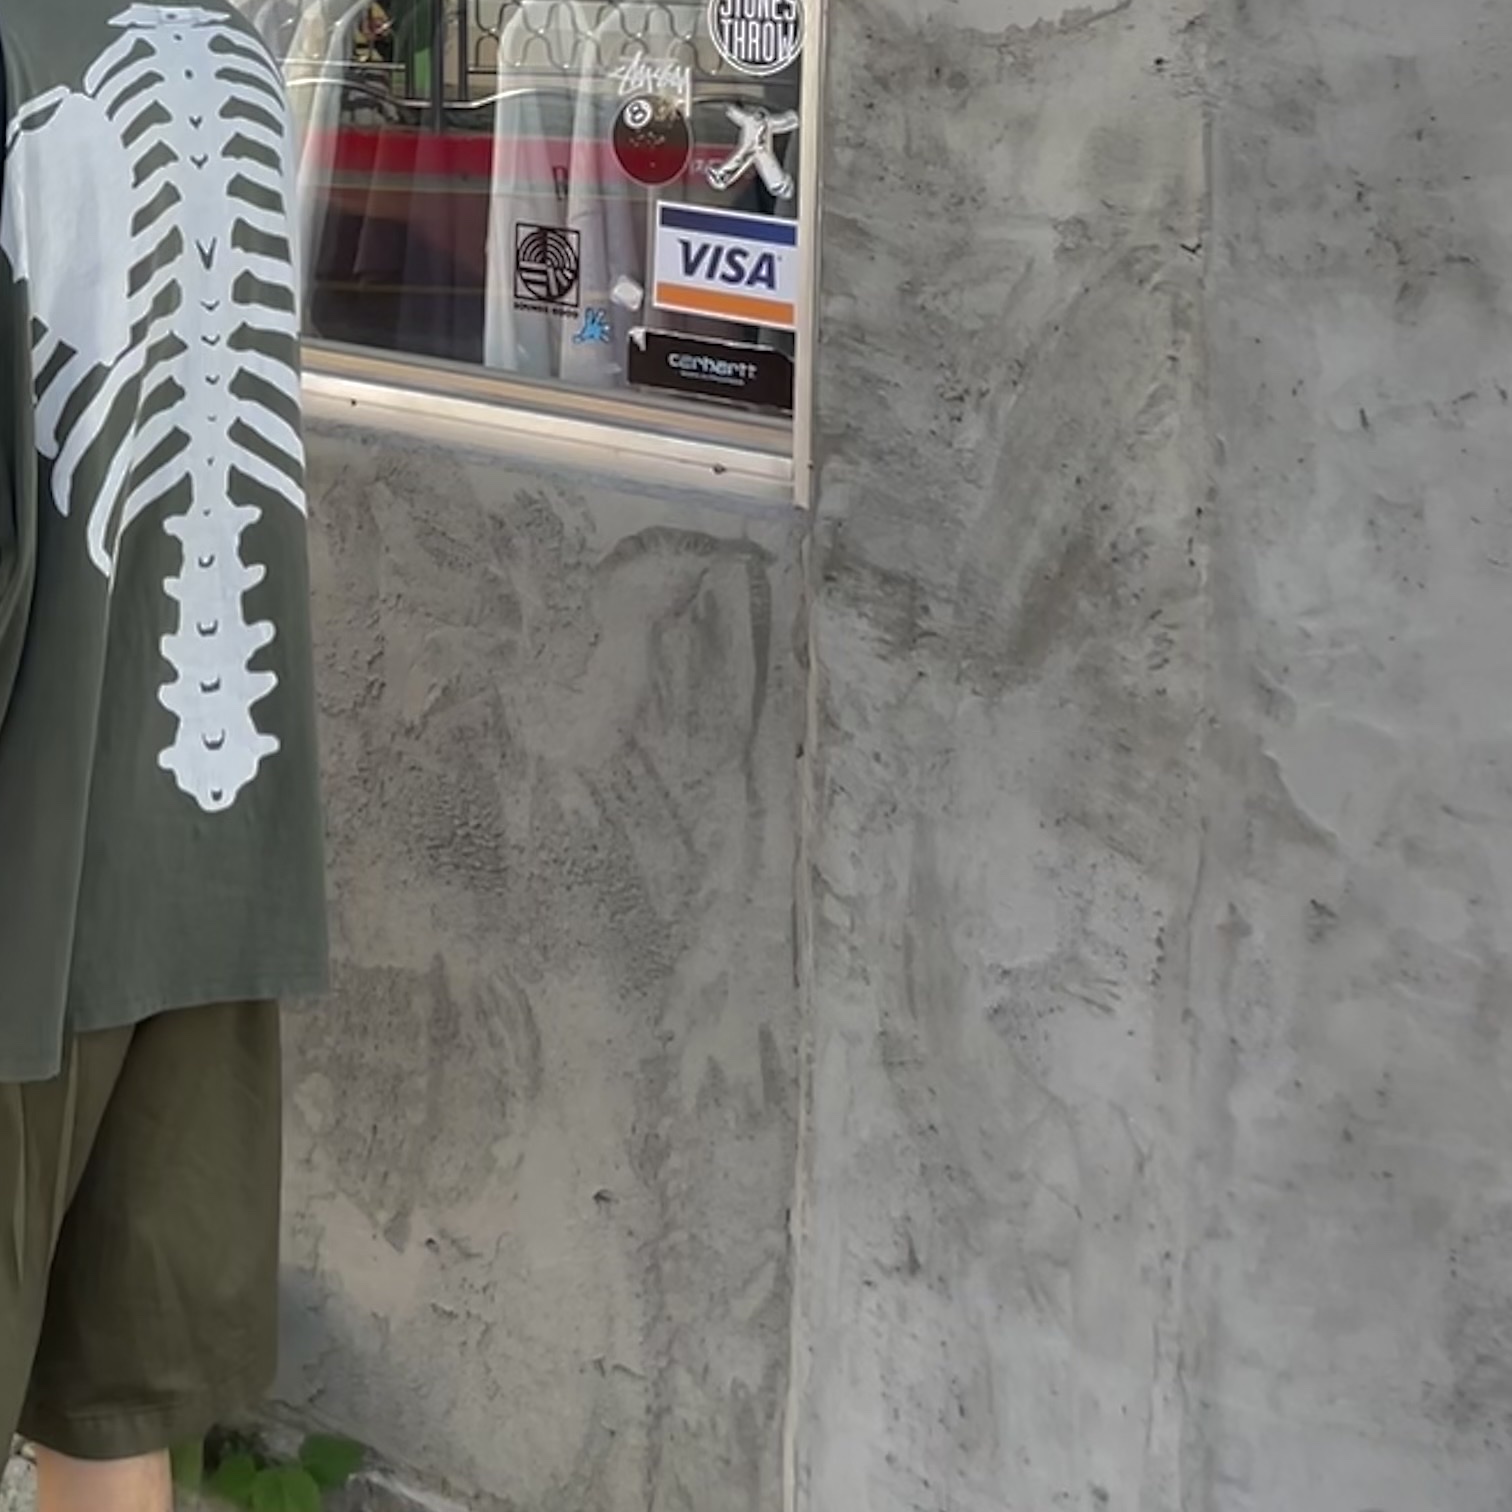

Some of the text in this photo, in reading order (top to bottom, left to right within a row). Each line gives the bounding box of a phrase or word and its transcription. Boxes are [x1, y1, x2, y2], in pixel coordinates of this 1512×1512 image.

[720, 18, 795, 63] THROW
[678, 237, 777, 290] VISA
[667, 352, 758, 380] carhartt
